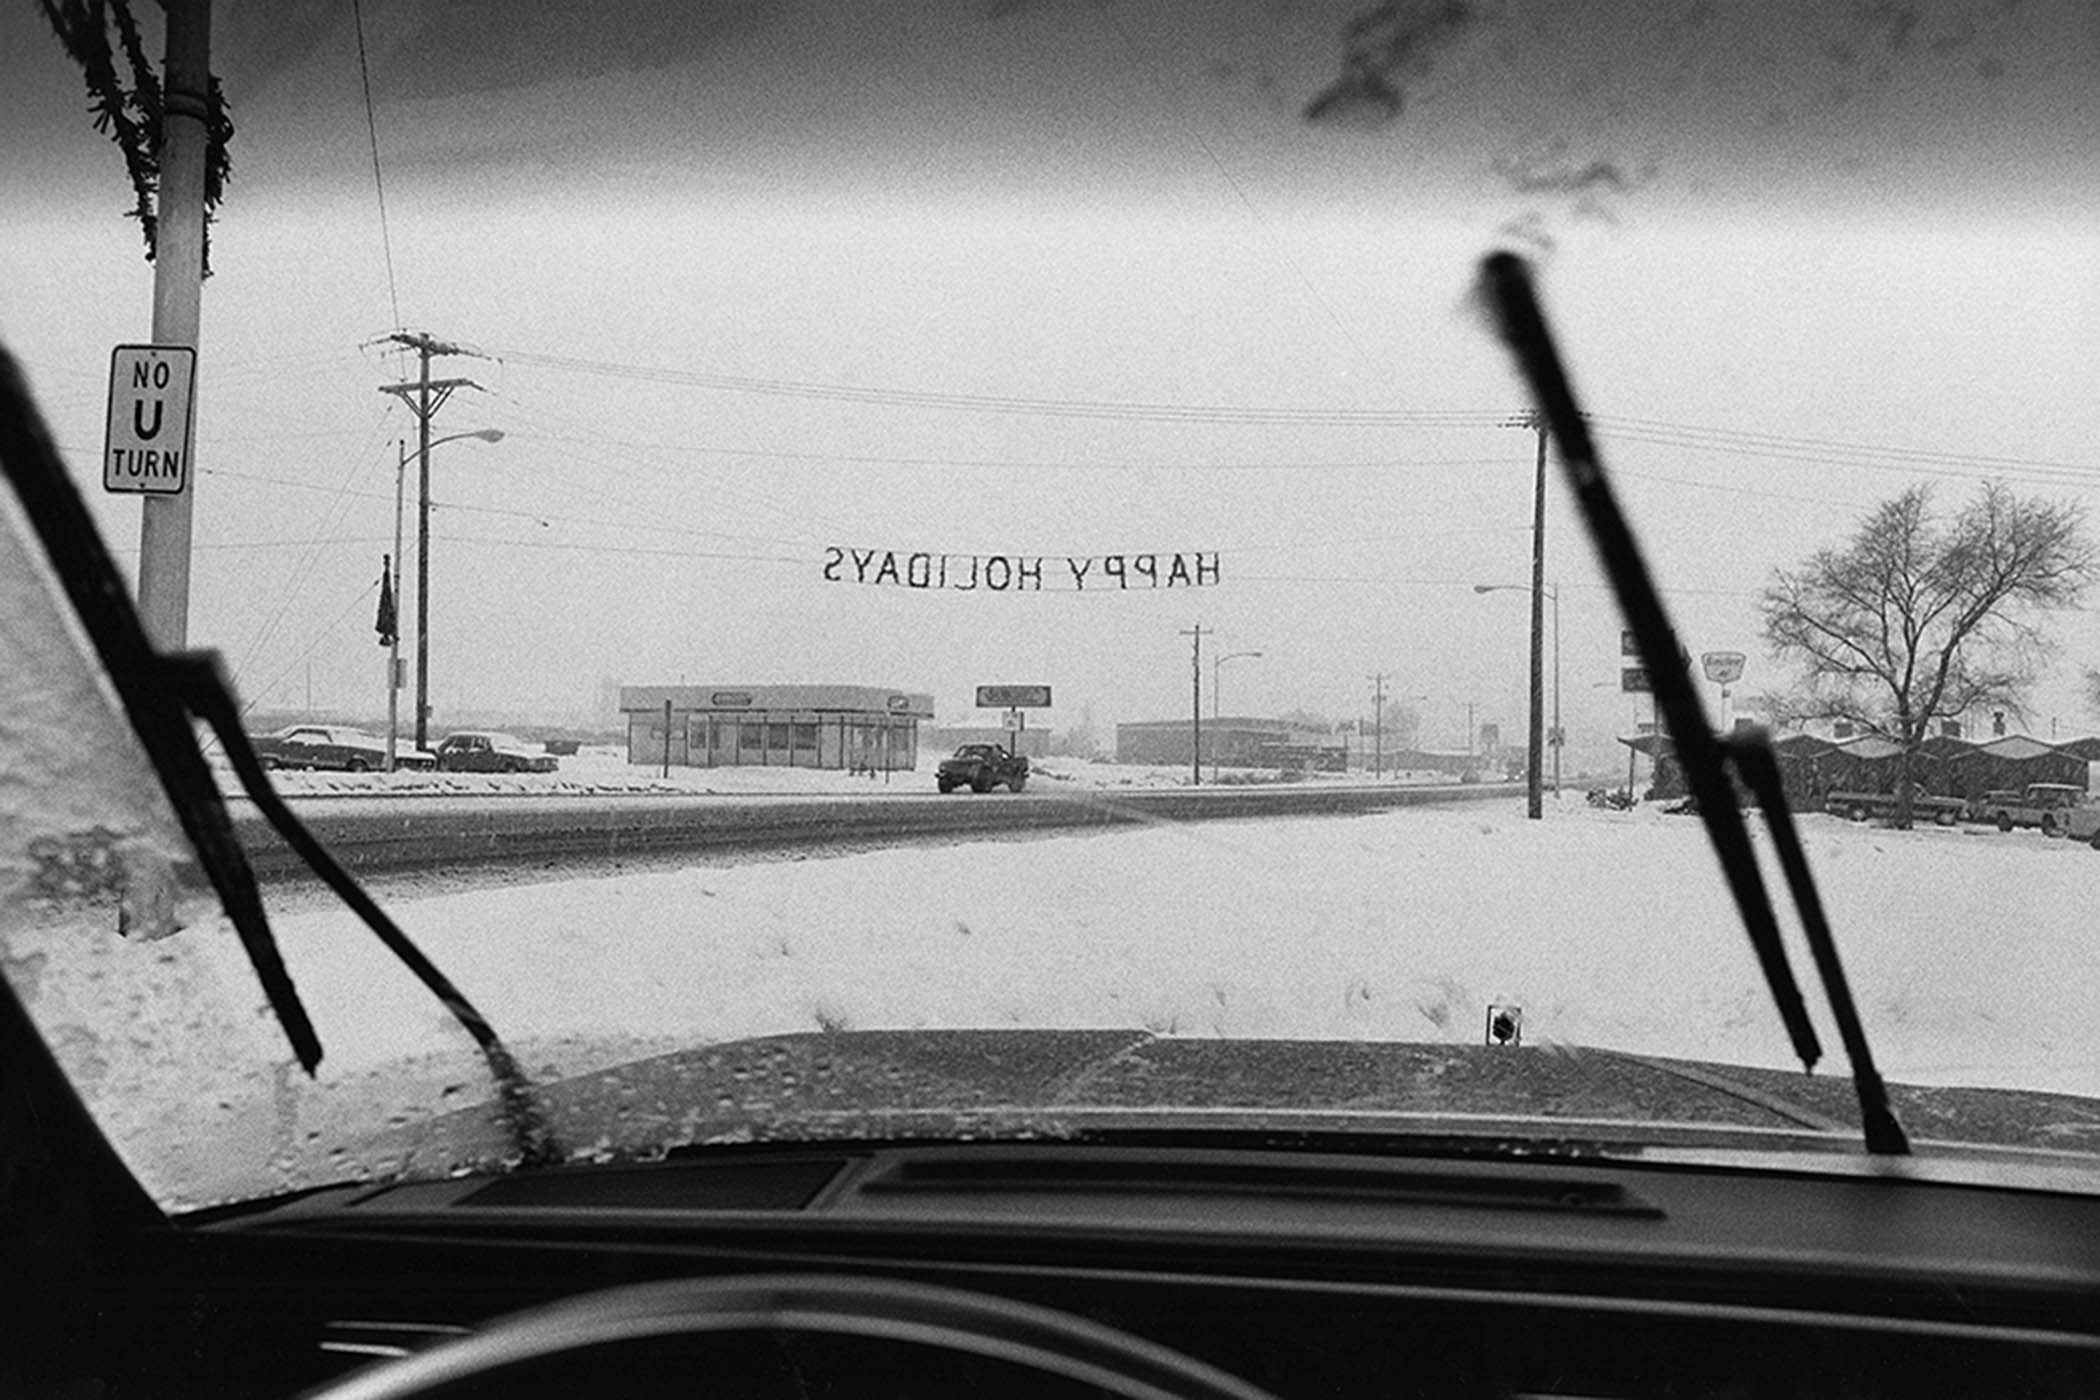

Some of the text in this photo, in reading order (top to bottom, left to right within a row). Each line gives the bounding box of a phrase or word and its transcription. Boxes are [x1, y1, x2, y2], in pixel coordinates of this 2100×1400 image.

[133, 361, 169, 389] NO
[134, 399, 163, 440] U
[113, 449, 179, 478] TURN
